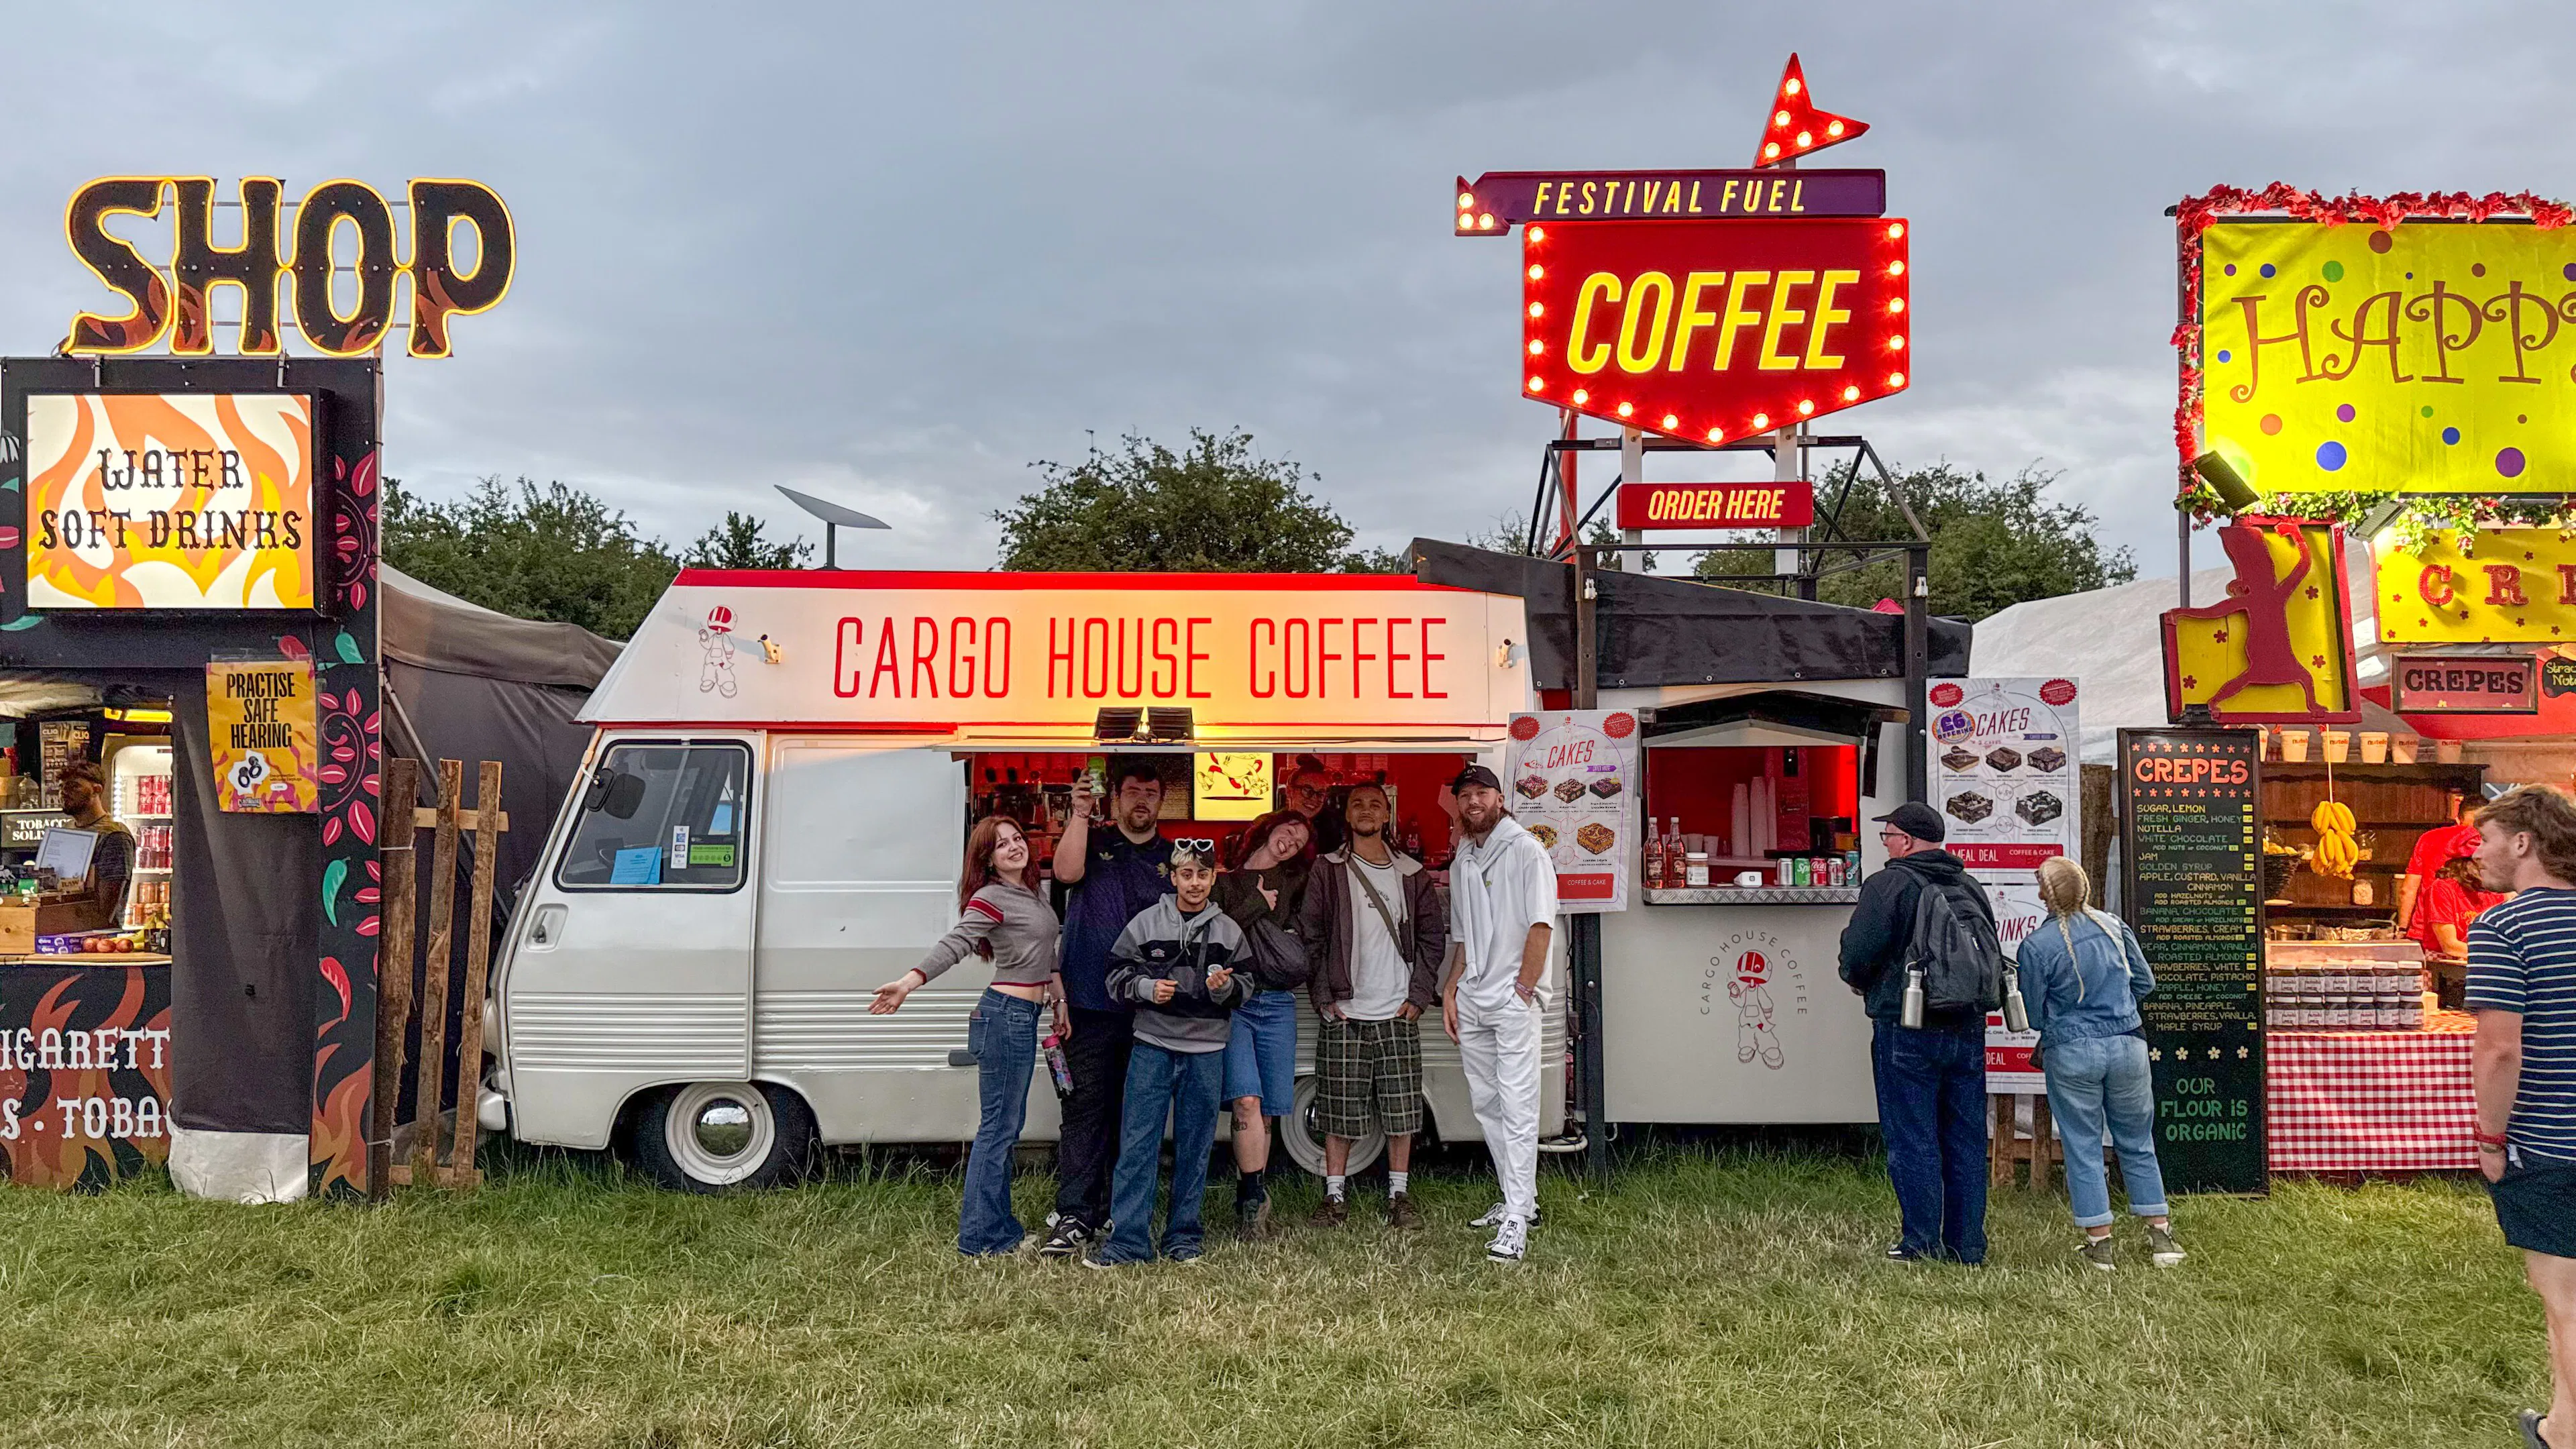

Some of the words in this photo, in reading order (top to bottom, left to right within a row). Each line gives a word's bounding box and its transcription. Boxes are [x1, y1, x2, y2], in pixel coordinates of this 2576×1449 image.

[1533, 180, 1703, 214] FESTIVAL
[1720, 180, 1805, 213] FUEL
[62, 175, 516, 358] SHOP
[1566, 270, 1861, 374] COFFEE
[2230, 280, 2576, 403] HAPP
[97, 447, 244, 491] WATER
[1648, 490, 1719, 520] ORDER
[1725, 489, 1786, 520] HERE
[38, 509, 131, 551] SOFT
[148, 509, 303, 551] DRINKS
[833, 616, 1011, 699] CARGO
[1047, 617, 1212, 699] HOUSE
[1250, 618, 1448, 699] COFFEE
[227, 673, 295, 698] PRACTISE
[2405, 669, 2523, 694] CREPES
[244, 698, 278, 722] SAFE
[1941, 713, 1966, 733] £6
[1976, 707, 2030, 737] CAKES
[231, 723, 292, 749] HEARING
[1938, 727, 1974, 740] OFFERING
[1547, 740, 1595, 769] CAKES
[2135, 758, 2249, 784] CREPES
[2173, 804, 2206, 813] LEMON
[2137, 815, 2168, 823] FRESH
[2211, 815, 2242, 823] HONEY
[2170, 835, 2228, 843] CHOCOLATE
[1979, 849, 1998, 862] DEAL
[2139, 863, 2177, 871] GOLDEN
[2182, 863, 2212, 871] SYRUP
[62, 879, 79, 888] RAW
[2220, 873, 2256, 881] VANILLA
[2182, 908, 2237, 916] CHOCOLATE
[2213, 925, 2242, 933] CREAM
[2222, 943, 2257, 951] VANILLA
[1701, 957, 1720, 1015] CARGO
[1719, 930, 1778, 953] HOUSE
[1780, 949, 1807, 1015] COFFEE
[2150, 963, 2211, 971] TRAWBERRIES,
[2155, 973, 2207, 981] HOCOLATE,
[2197, 983, 2228, 991] HONEY
[2156, 1023, 2186, 1031] MAPLE
[2192, 1023, 2222, 1031] SYRUP
[1986, 1052, 2006, 1065] DEAL
[2176, 1077, 2215, 1094] OUR
[56, 1095, 172, 1139] TOBA
[2161, 1100, 2222, 1117] FLOUR
